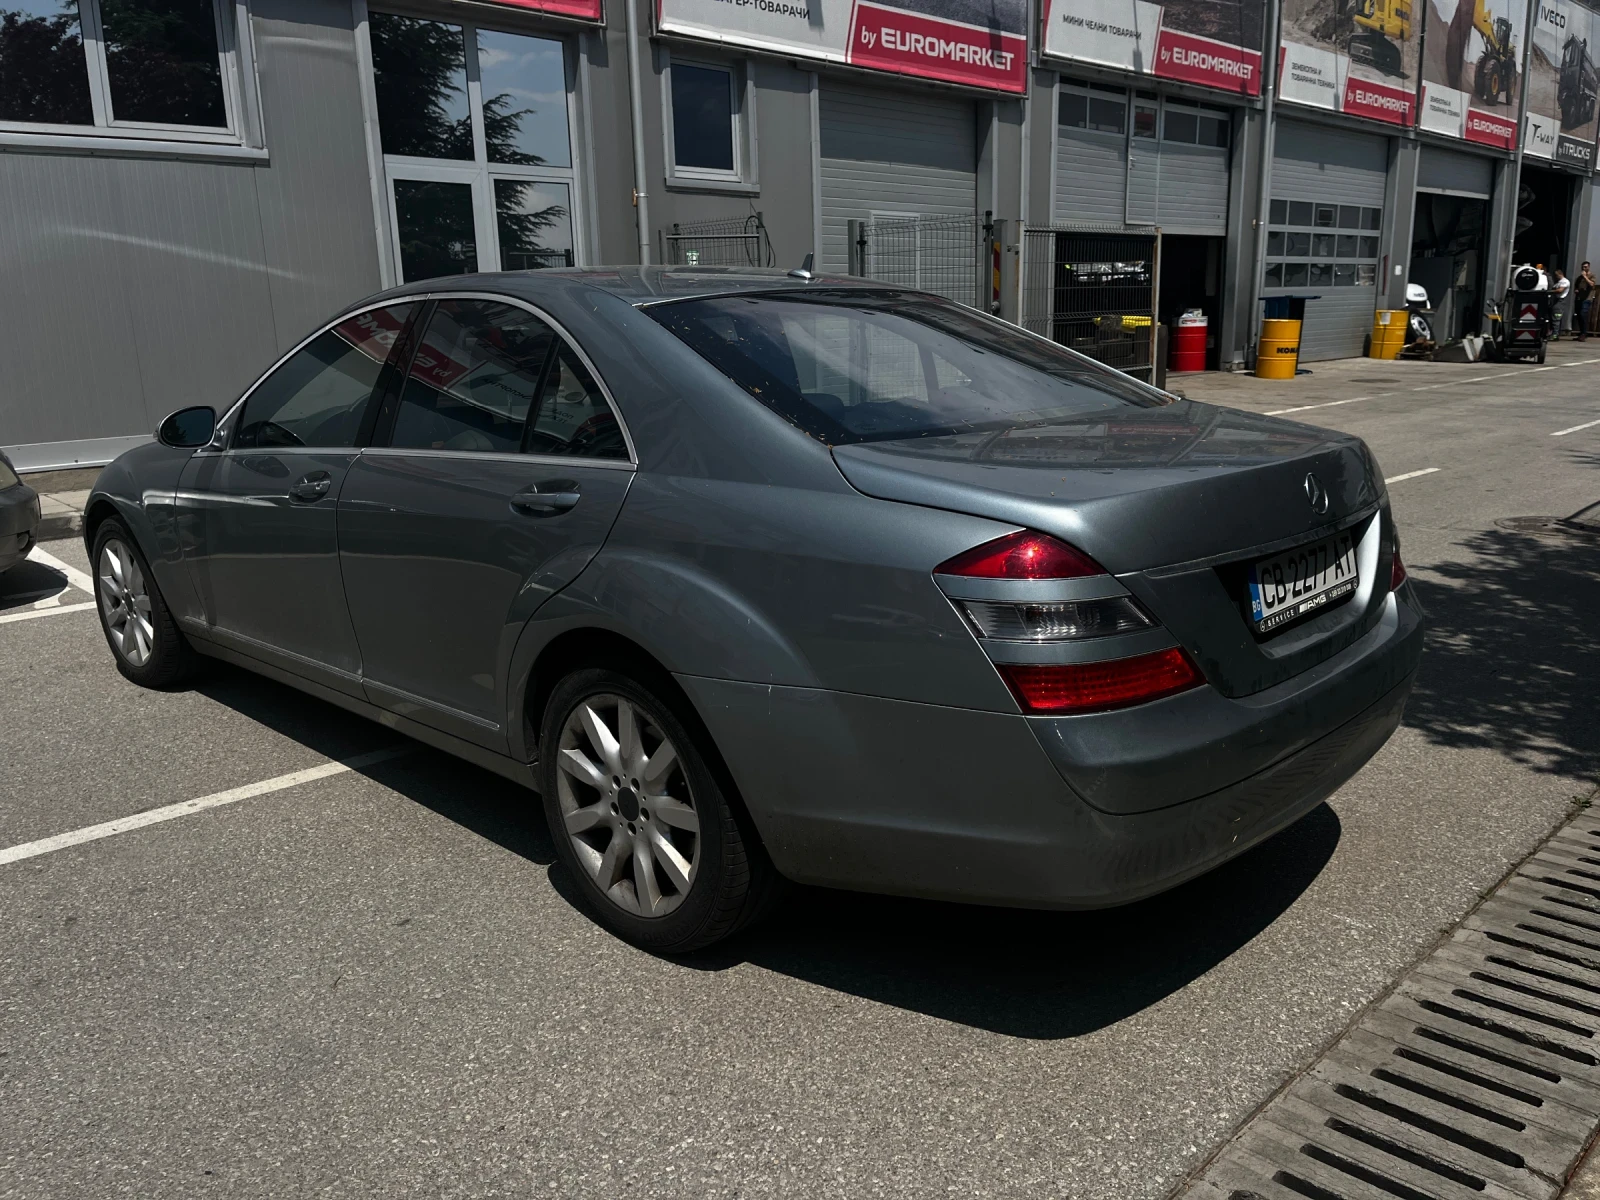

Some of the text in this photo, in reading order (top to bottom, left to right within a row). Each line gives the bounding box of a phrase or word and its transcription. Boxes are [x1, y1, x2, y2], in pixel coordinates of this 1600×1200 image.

[1062, 14, 1084, 27] МИНИ
[1541, 6, 1566, 28] IVECO
[861, 25, 1014, 71] by EUROMARKET
[1161, 46, 1253, 79] by EUROMARKET
[1347, 90, 1354, 104] by
[1355, 90, 1410, 114] EUROMARKET
[1473, 119, 1512, 138] EUROMARKET
[1532, 124, 1554, 145] T-WAY
[1261, 535, 1352, 609] CB 2277 AT
[1252, 599, 1261, 613] BG
[1267, 594, 1327, 627] SERVICE AMG
